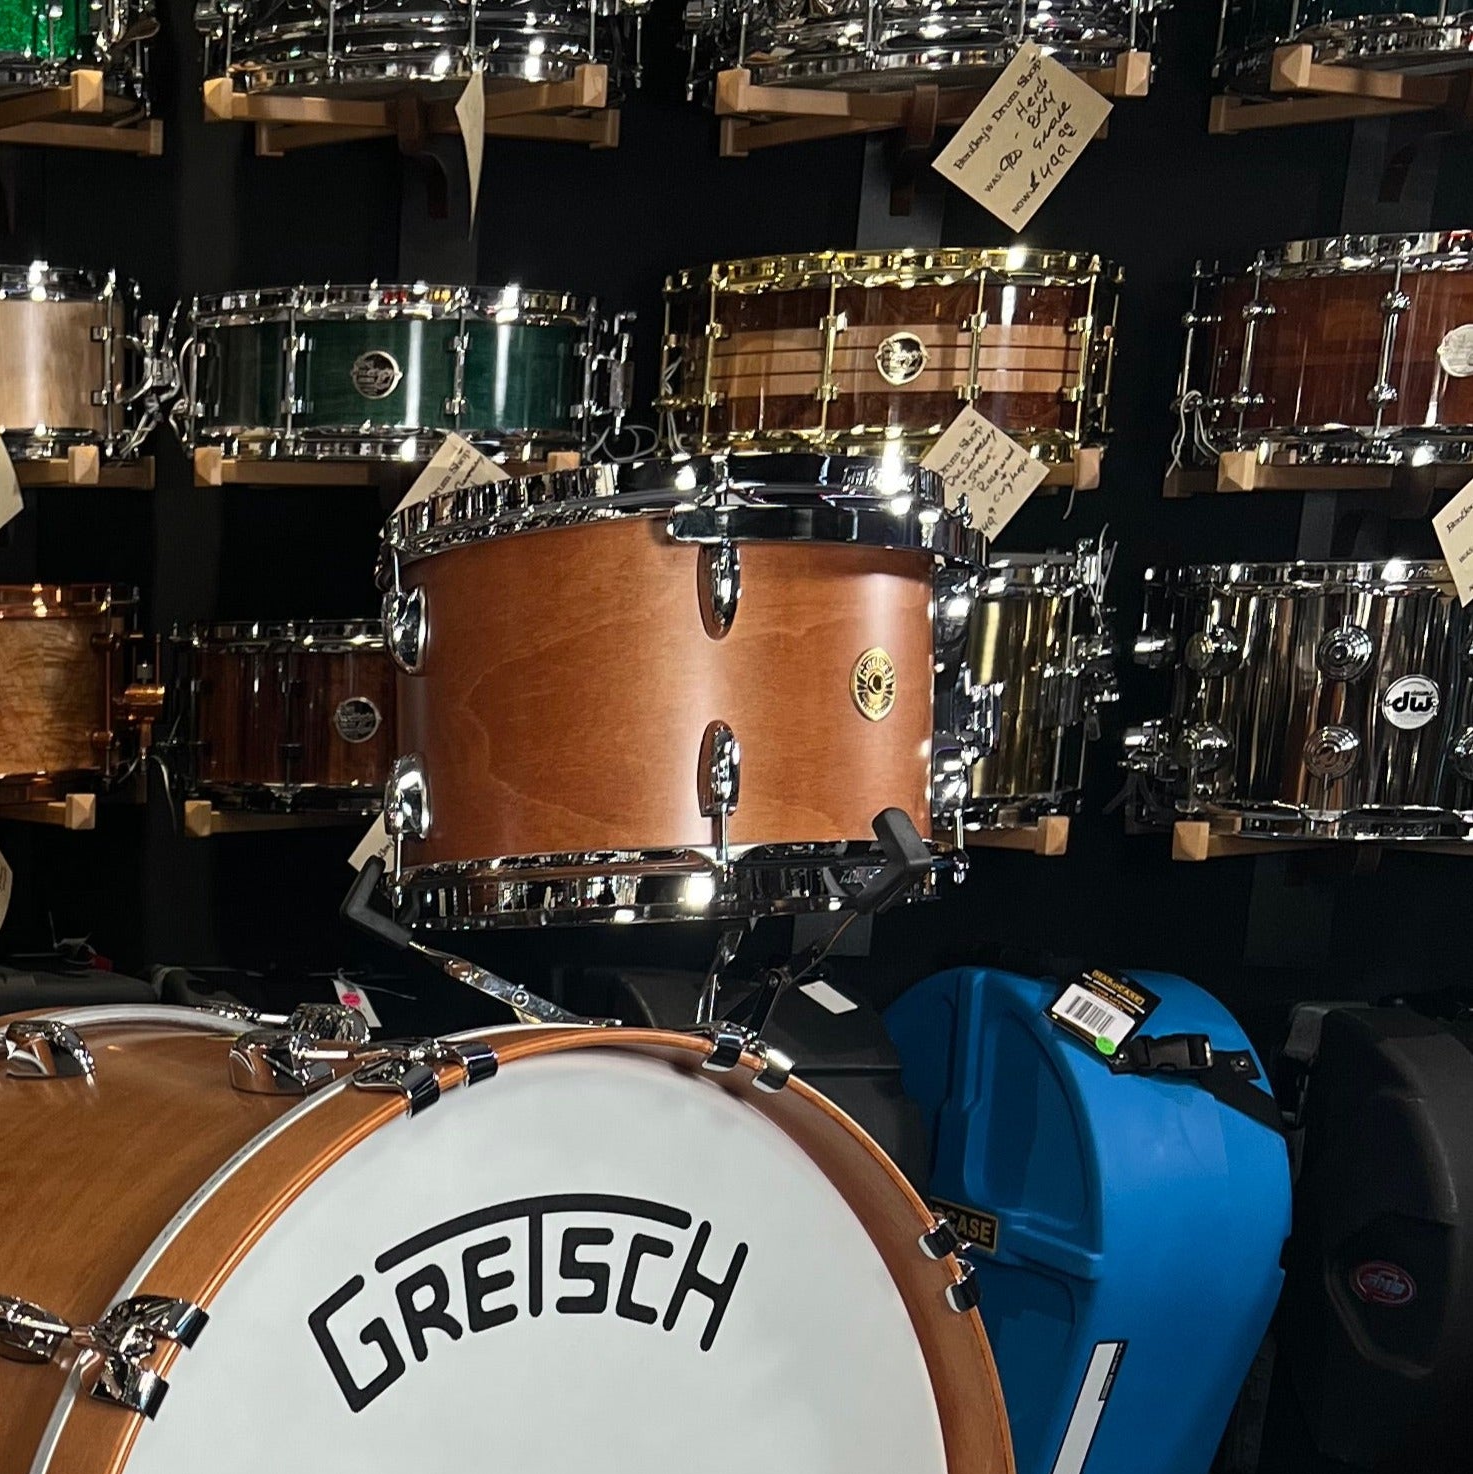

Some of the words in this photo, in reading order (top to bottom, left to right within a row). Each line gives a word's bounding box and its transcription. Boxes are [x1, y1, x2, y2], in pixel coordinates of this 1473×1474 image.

[953, 124, 993, 170] Bentley's
[991, 90, 1020, 122] Drum
[1016, 56, 1041, 88] Shop
[958, 423, 983, 450] Shop
[308, 1192, 750, 1414] GRETSCH
